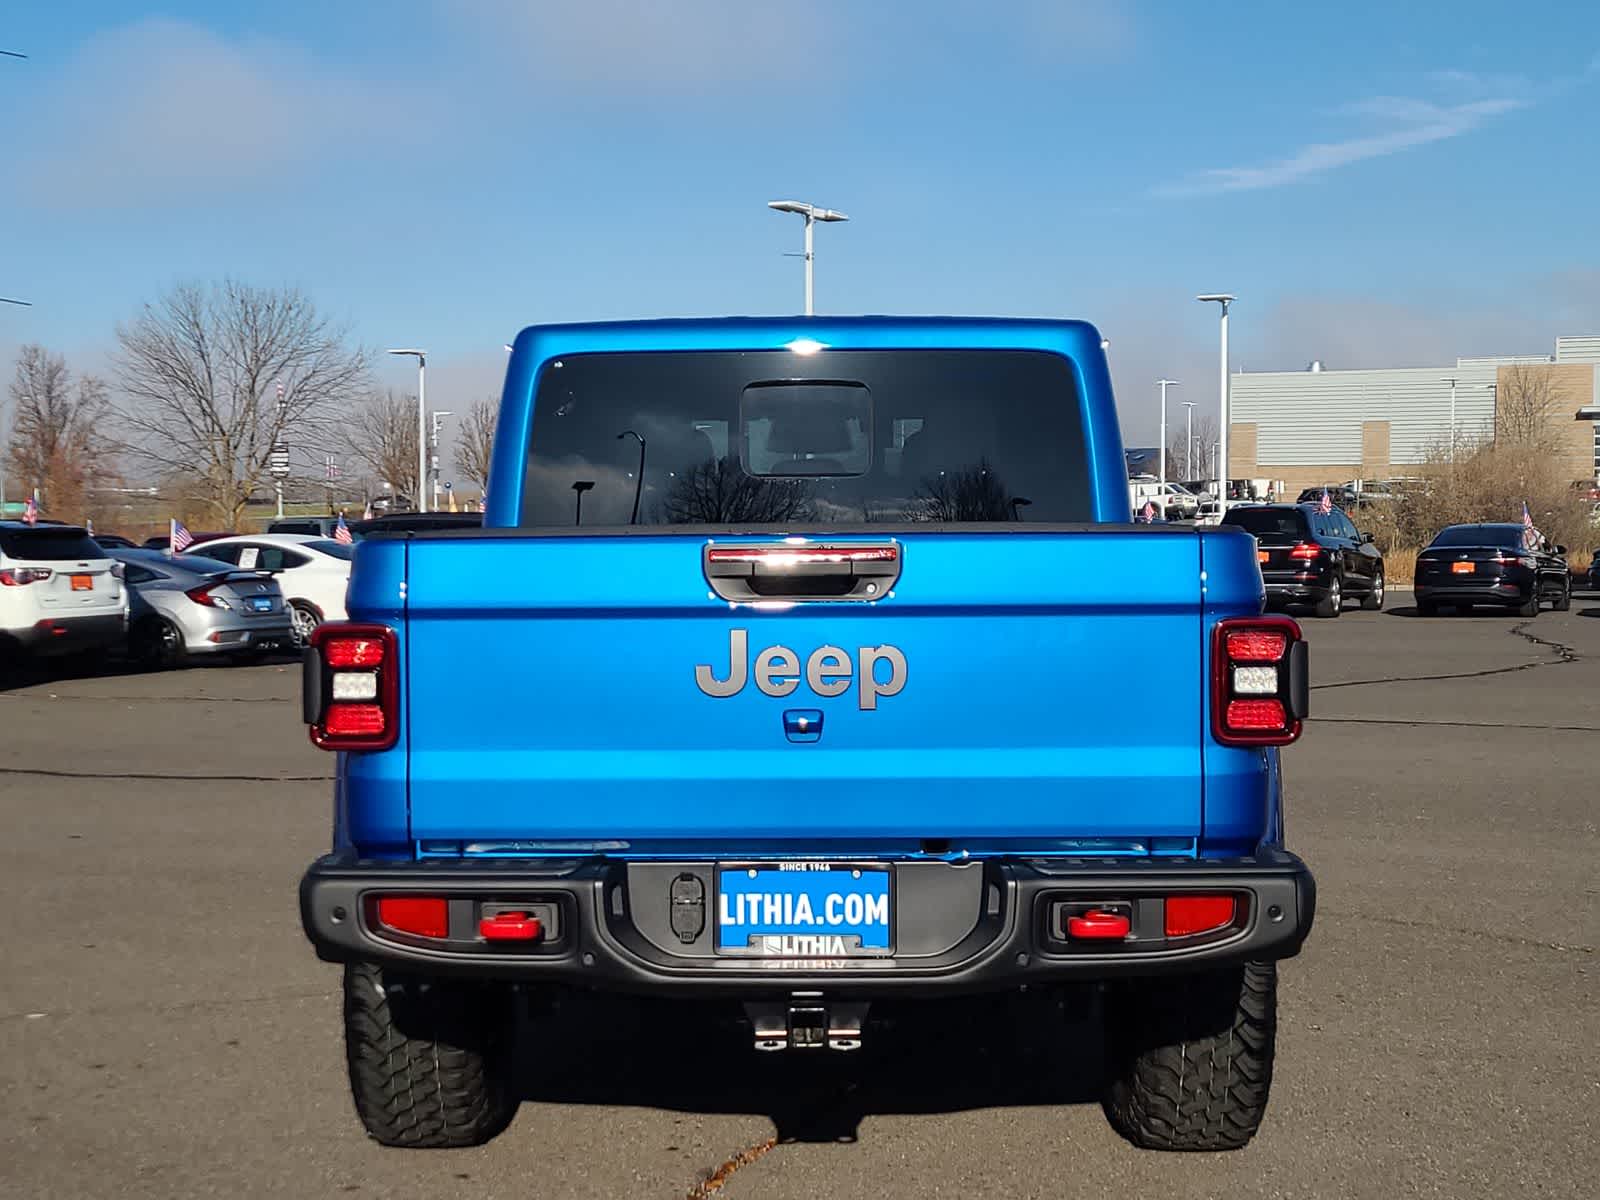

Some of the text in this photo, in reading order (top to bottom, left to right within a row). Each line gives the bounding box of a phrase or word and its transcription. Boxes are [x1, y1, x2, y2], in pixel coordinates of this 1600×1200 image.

[695, 628, 908, 710] Jeep
[779, 863, 806, 871] SINCE
[719, 893, 888, 926] LITHIA.COM
[782, 936, 847, 955] LITHIA
